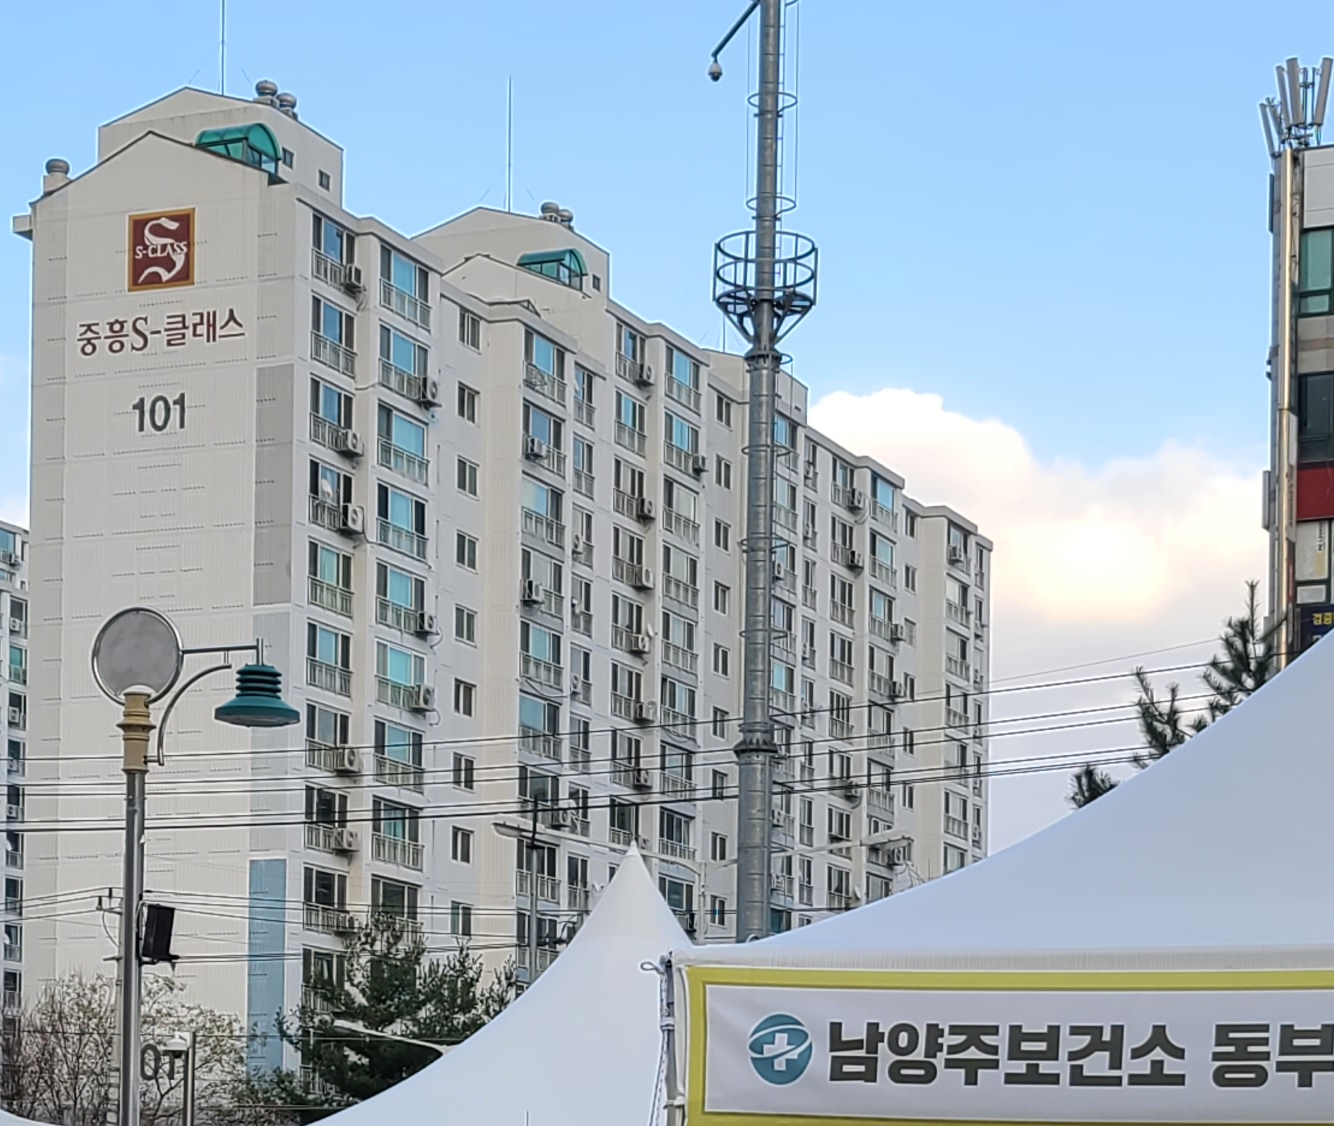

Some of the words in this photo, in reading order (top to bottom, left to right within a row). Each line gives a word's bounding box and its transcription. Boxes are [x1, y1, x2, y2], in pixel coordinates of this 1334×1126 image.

[135, 240, 188, 259] S-CLASS
[76, 308, 246, 356] 중흥S-클래스
[131, 392, 187, 433] 101
[140, 1043, 175, 1081] 01
[826, 1020, 1187, 1088] 남양주보건소
